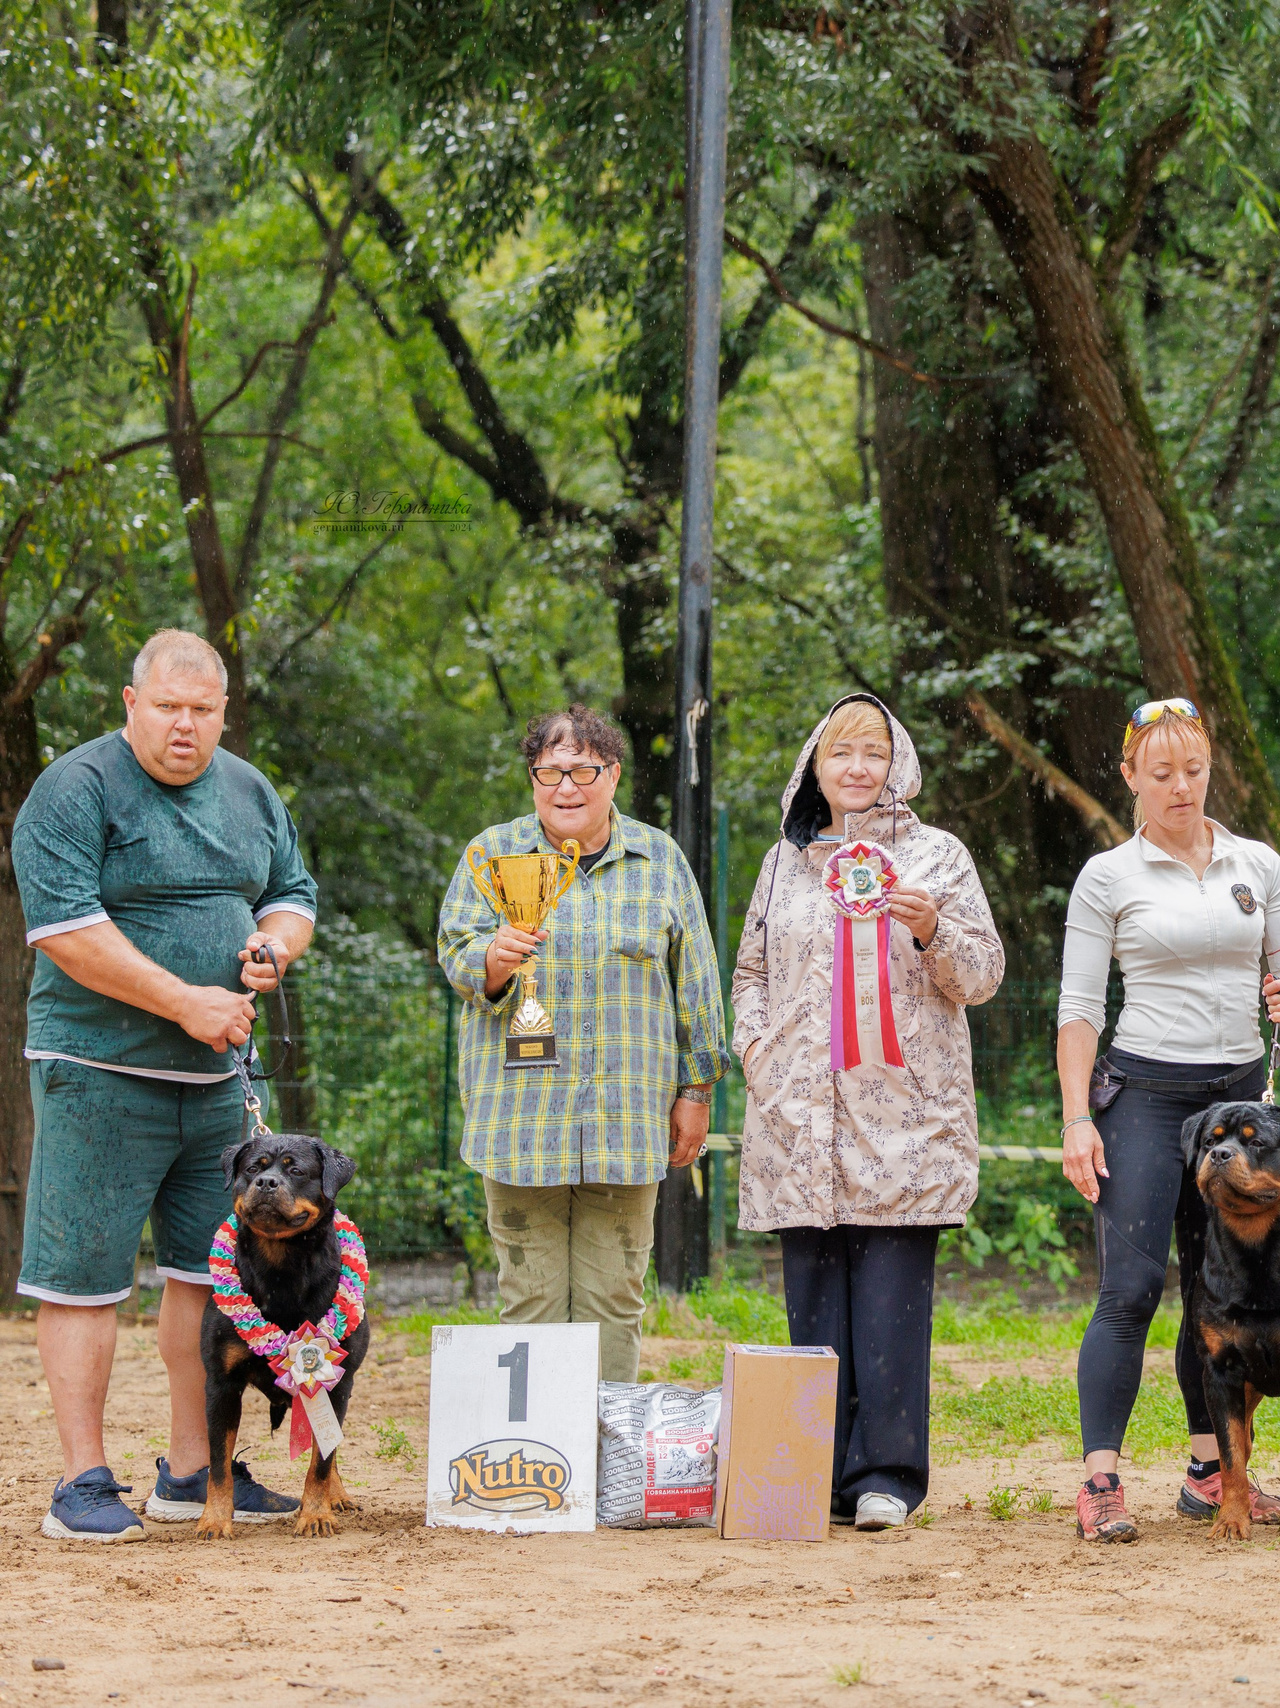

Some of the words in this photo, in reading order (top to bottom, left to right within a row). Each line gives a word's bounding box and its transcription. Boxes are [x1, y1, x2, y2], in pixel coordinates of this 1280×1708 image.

[498, 1342, 529, 1422] 1
[604, 1406, 644, 1417] ЗООМЕНЮ
[605, 1446, 642, 1462] ЗООМЕНЮ
[604, 1461, 642, 1478] ЗООМЕНЮ
[647, 1451, 656, 1487] БРИДЕР
[450, 1448, 567, 1510] Nutro
[602, 1478, 641, 1494] ЗООМЕНЮ
[601, 1494, 641, 1509] ЗООМЕНЮ
